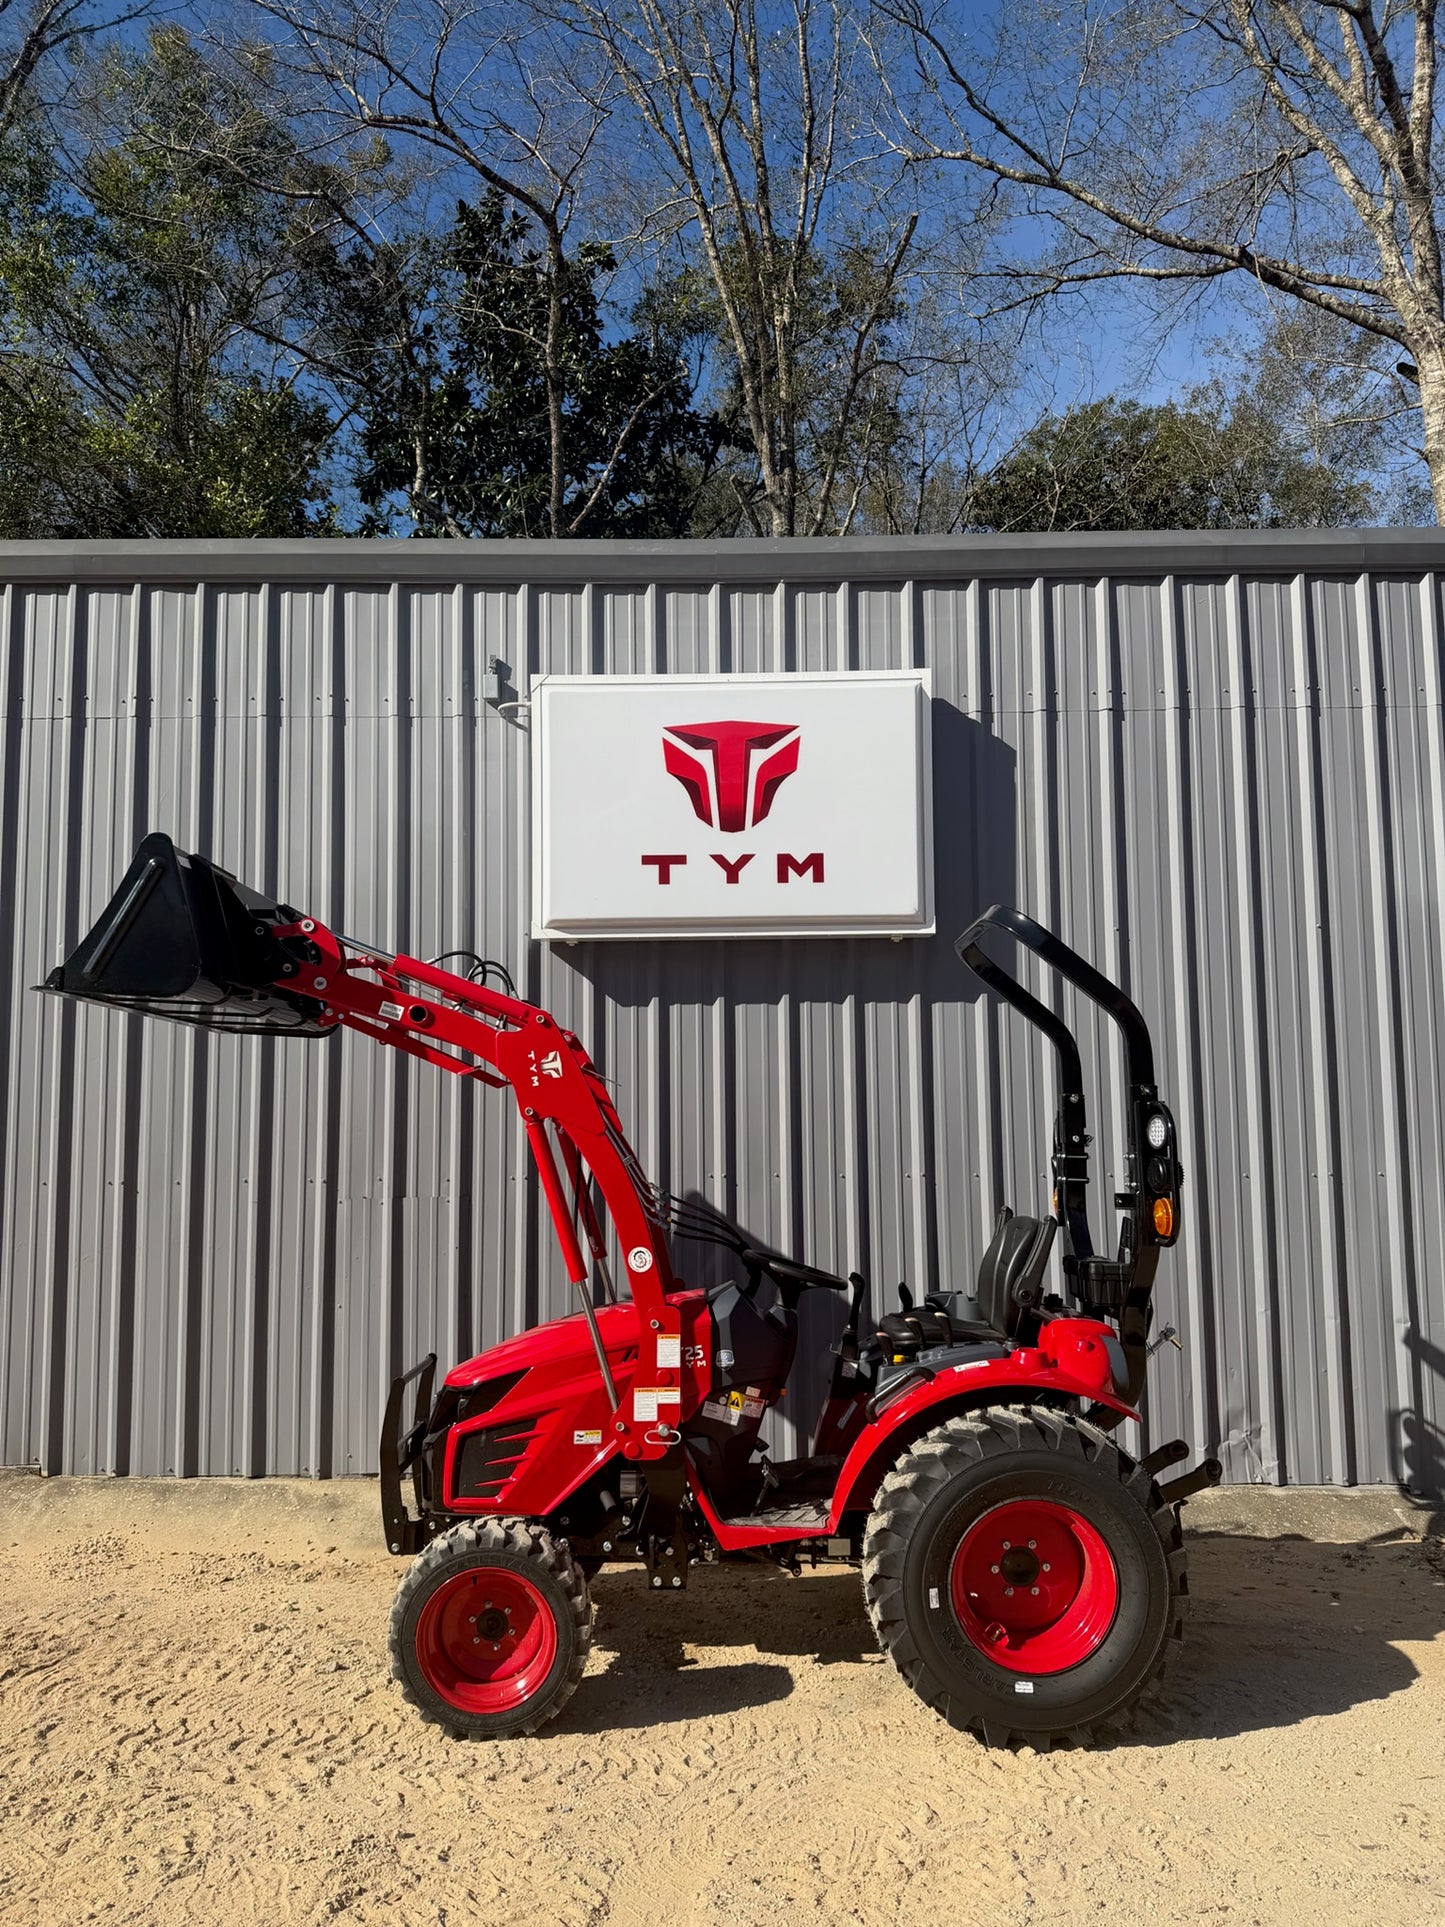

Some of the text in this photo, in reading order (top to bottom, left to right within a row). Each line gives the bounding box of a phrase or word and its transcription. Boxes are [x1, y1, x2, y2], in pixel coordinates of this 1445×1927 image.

[641, 853, 825, 885] TYM
[527, 1050, 540, 1087] TYM
[681, 1344, 704, 1361] 25
[685, 1360, 707, 1369] YM
